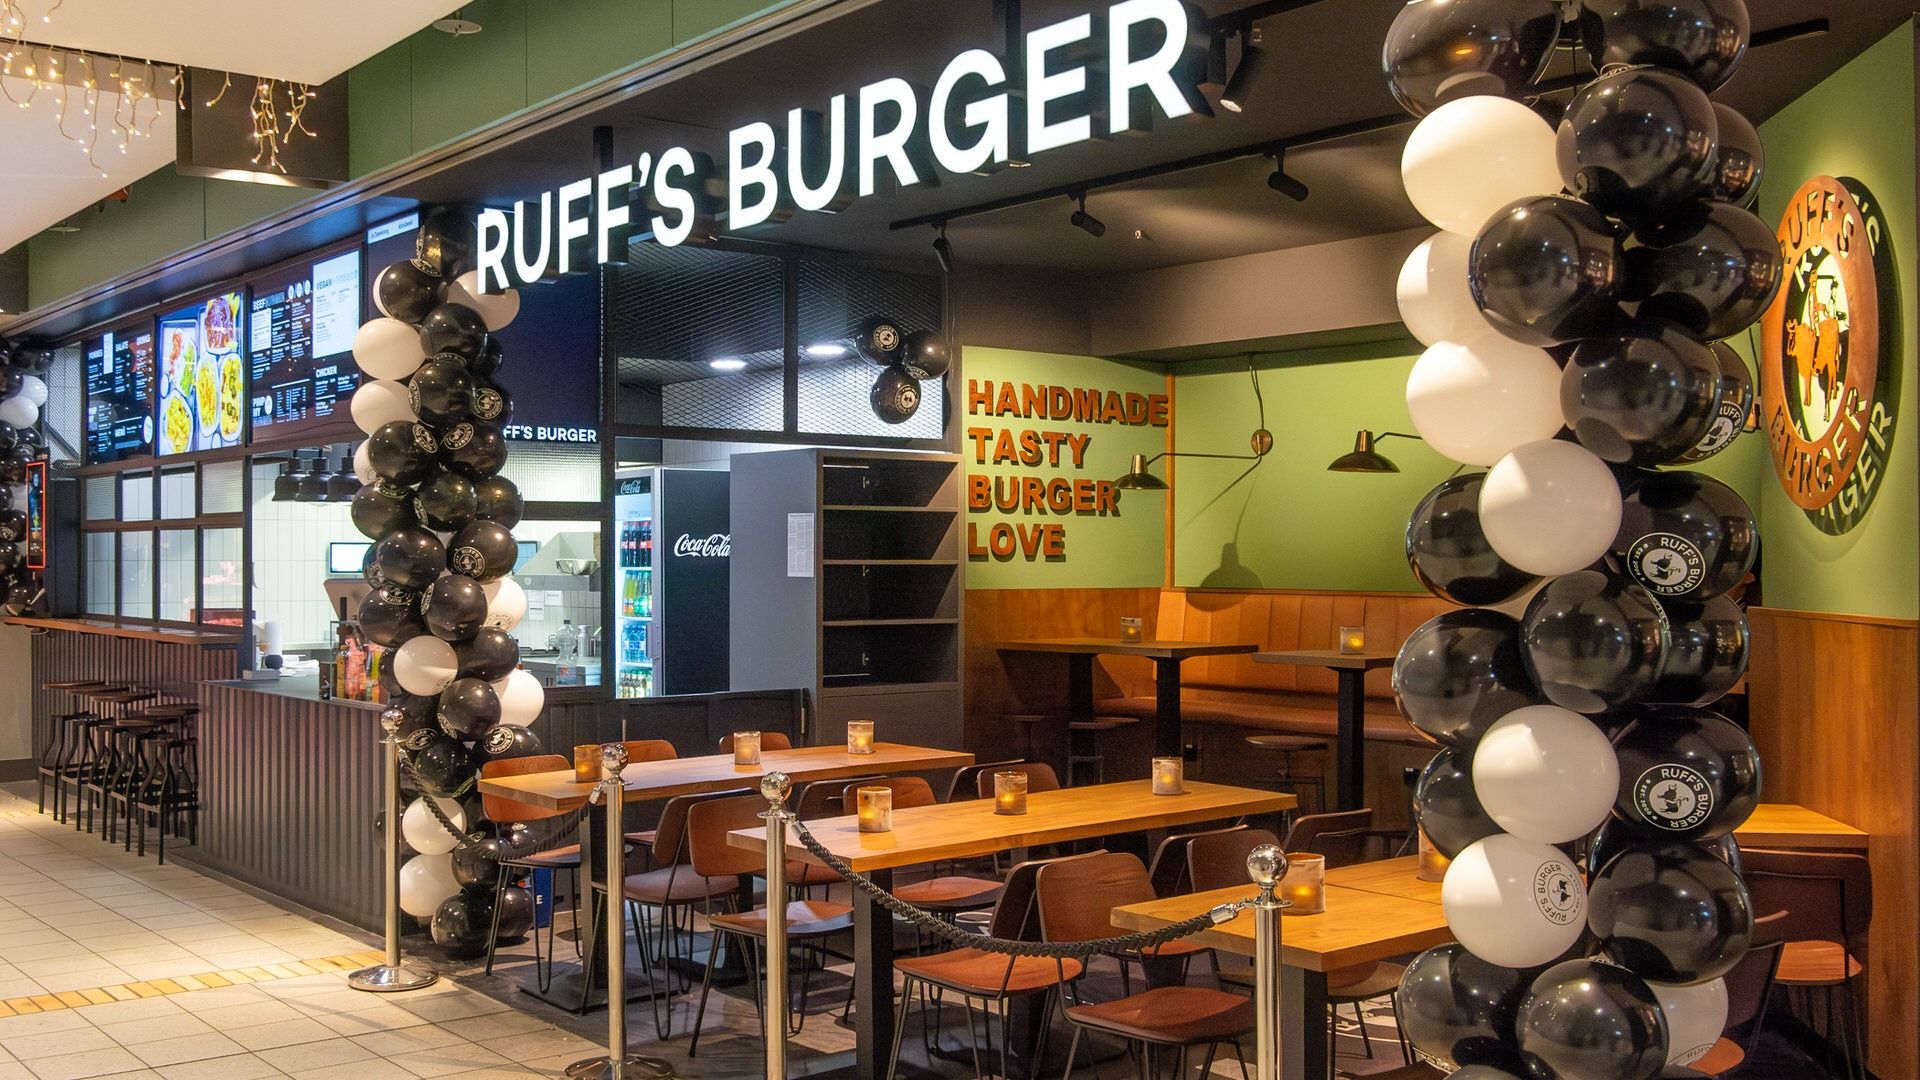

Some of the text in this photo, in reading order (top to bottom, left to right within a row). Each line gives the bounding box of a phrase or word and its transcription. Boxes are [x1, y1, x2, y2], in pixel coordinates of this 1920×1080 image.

[476, 0, 1193, 295] RUFF'S BURGER
[967, 379, 1169, 426] HANDMADE
[503, 425, 597, 442] FF'S BURGER
[967, 427, 1090, 466] TASTY
[1771, 386, 1868, 498] BURGER
[967, 475, 1118, 512] BURGER
[967, 522, 1066, 557] LOVE
[1656, 537, 1701, 593] RUFF'S BURGER
[1661, 768, 1709, 828] RUFF'S BURGER
[1537, 864, 1567, 921] RUFF'S BURGER
